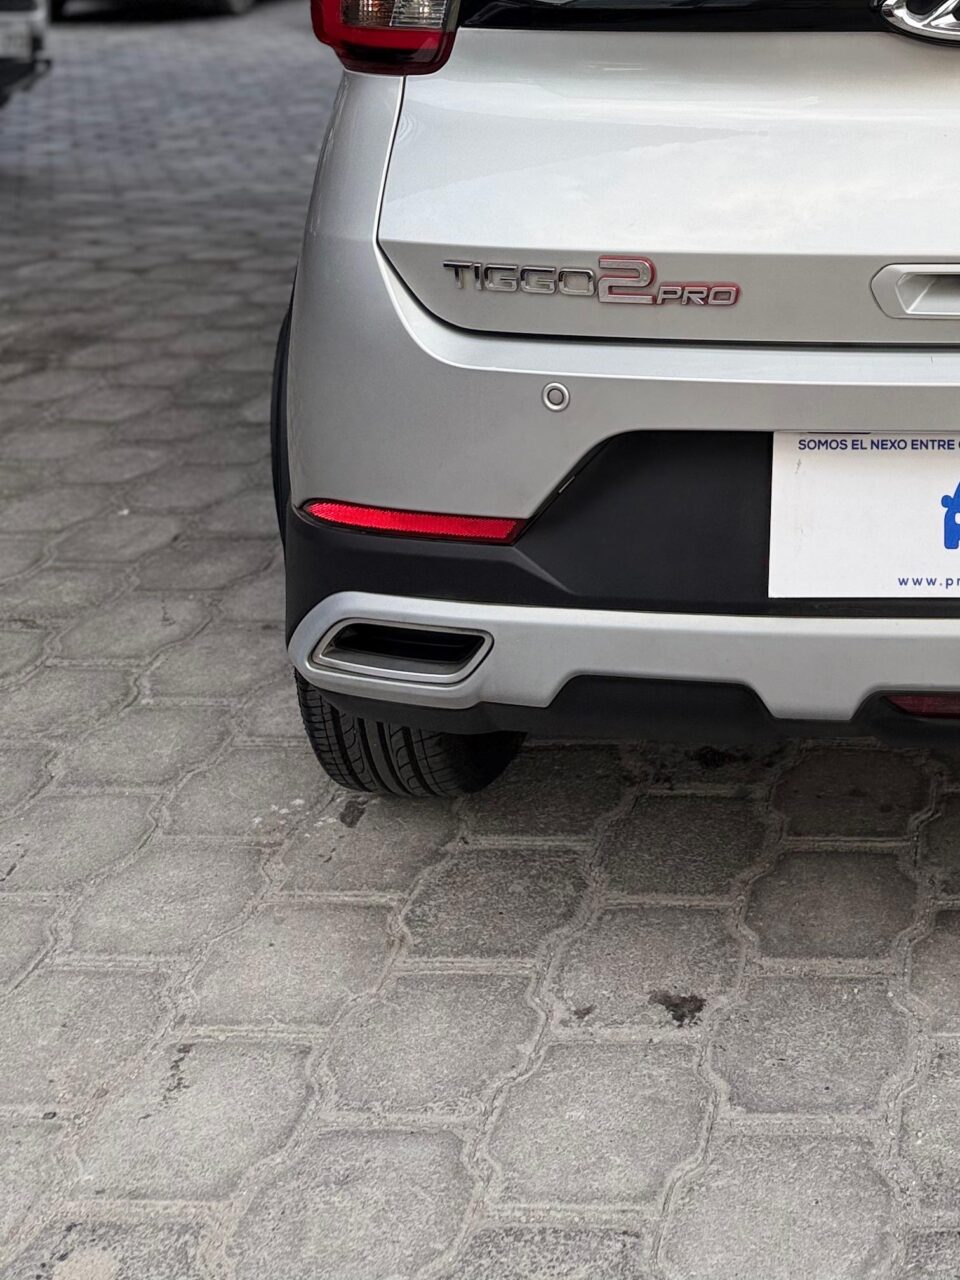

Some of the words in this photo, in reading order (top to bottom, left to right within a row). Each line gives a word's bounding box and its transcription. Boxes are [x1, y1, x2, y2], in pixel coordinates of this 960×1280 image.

[798, 438, 849, 451] SOMOS
[851, 439, 867, 451] EL
[870, 439, 908, 451] NEXO
[911, 439, 955, 451] ENTRE
